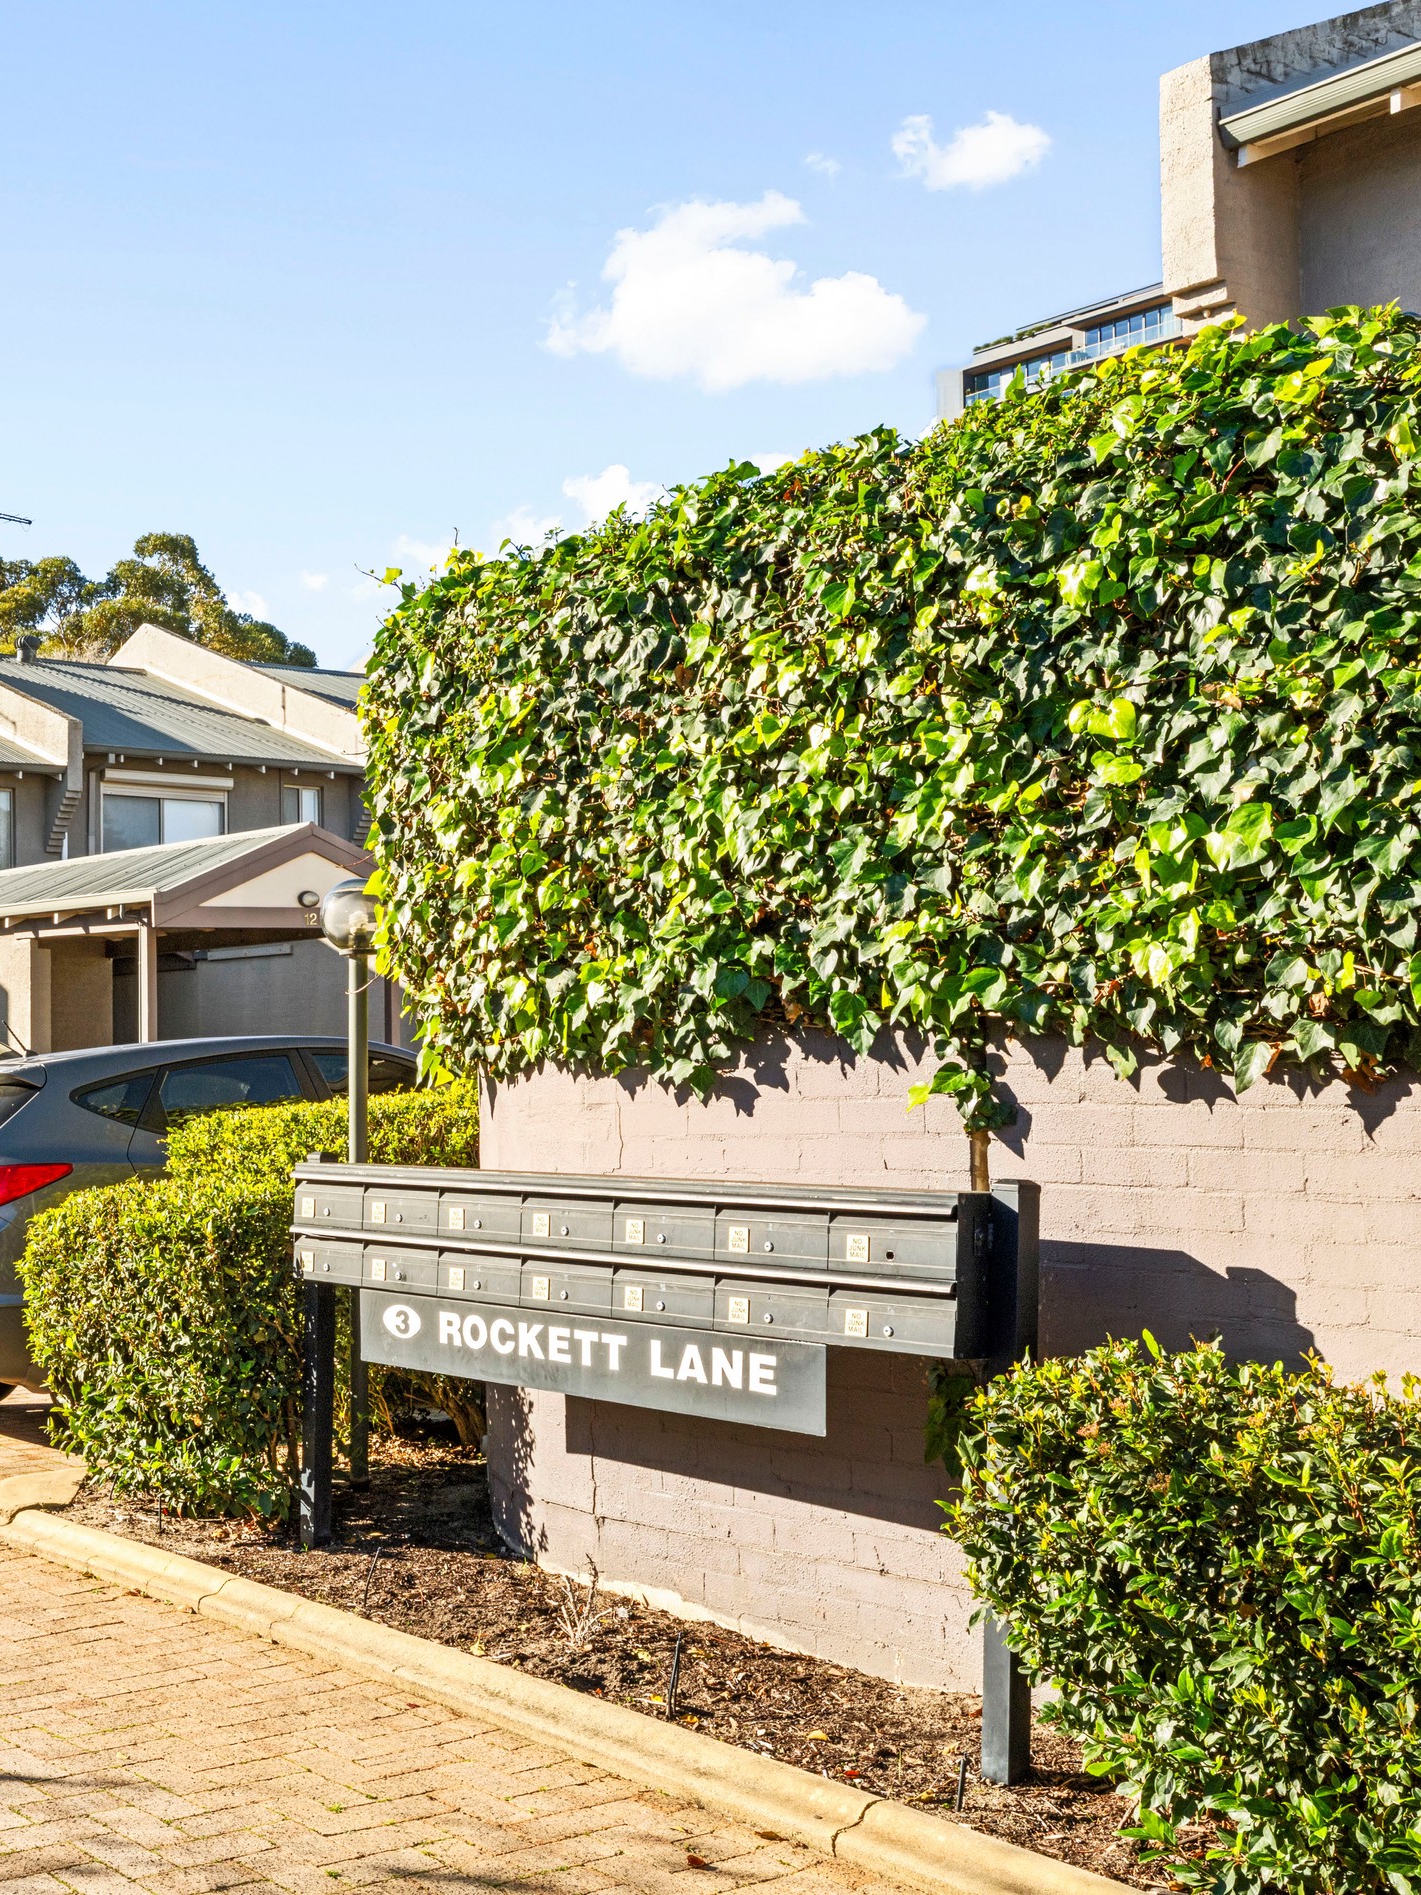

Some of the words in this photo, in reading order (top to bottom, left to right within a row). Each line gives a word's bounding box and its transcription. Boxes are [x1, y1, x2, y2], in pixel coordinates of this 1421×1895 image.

[304, 912, 318, 926] 12
[395, 1309, 410, 1334] 3
[439, 1311, 628, 1371] ROCKETT
[650, 1339, 778, 1396] LANE
